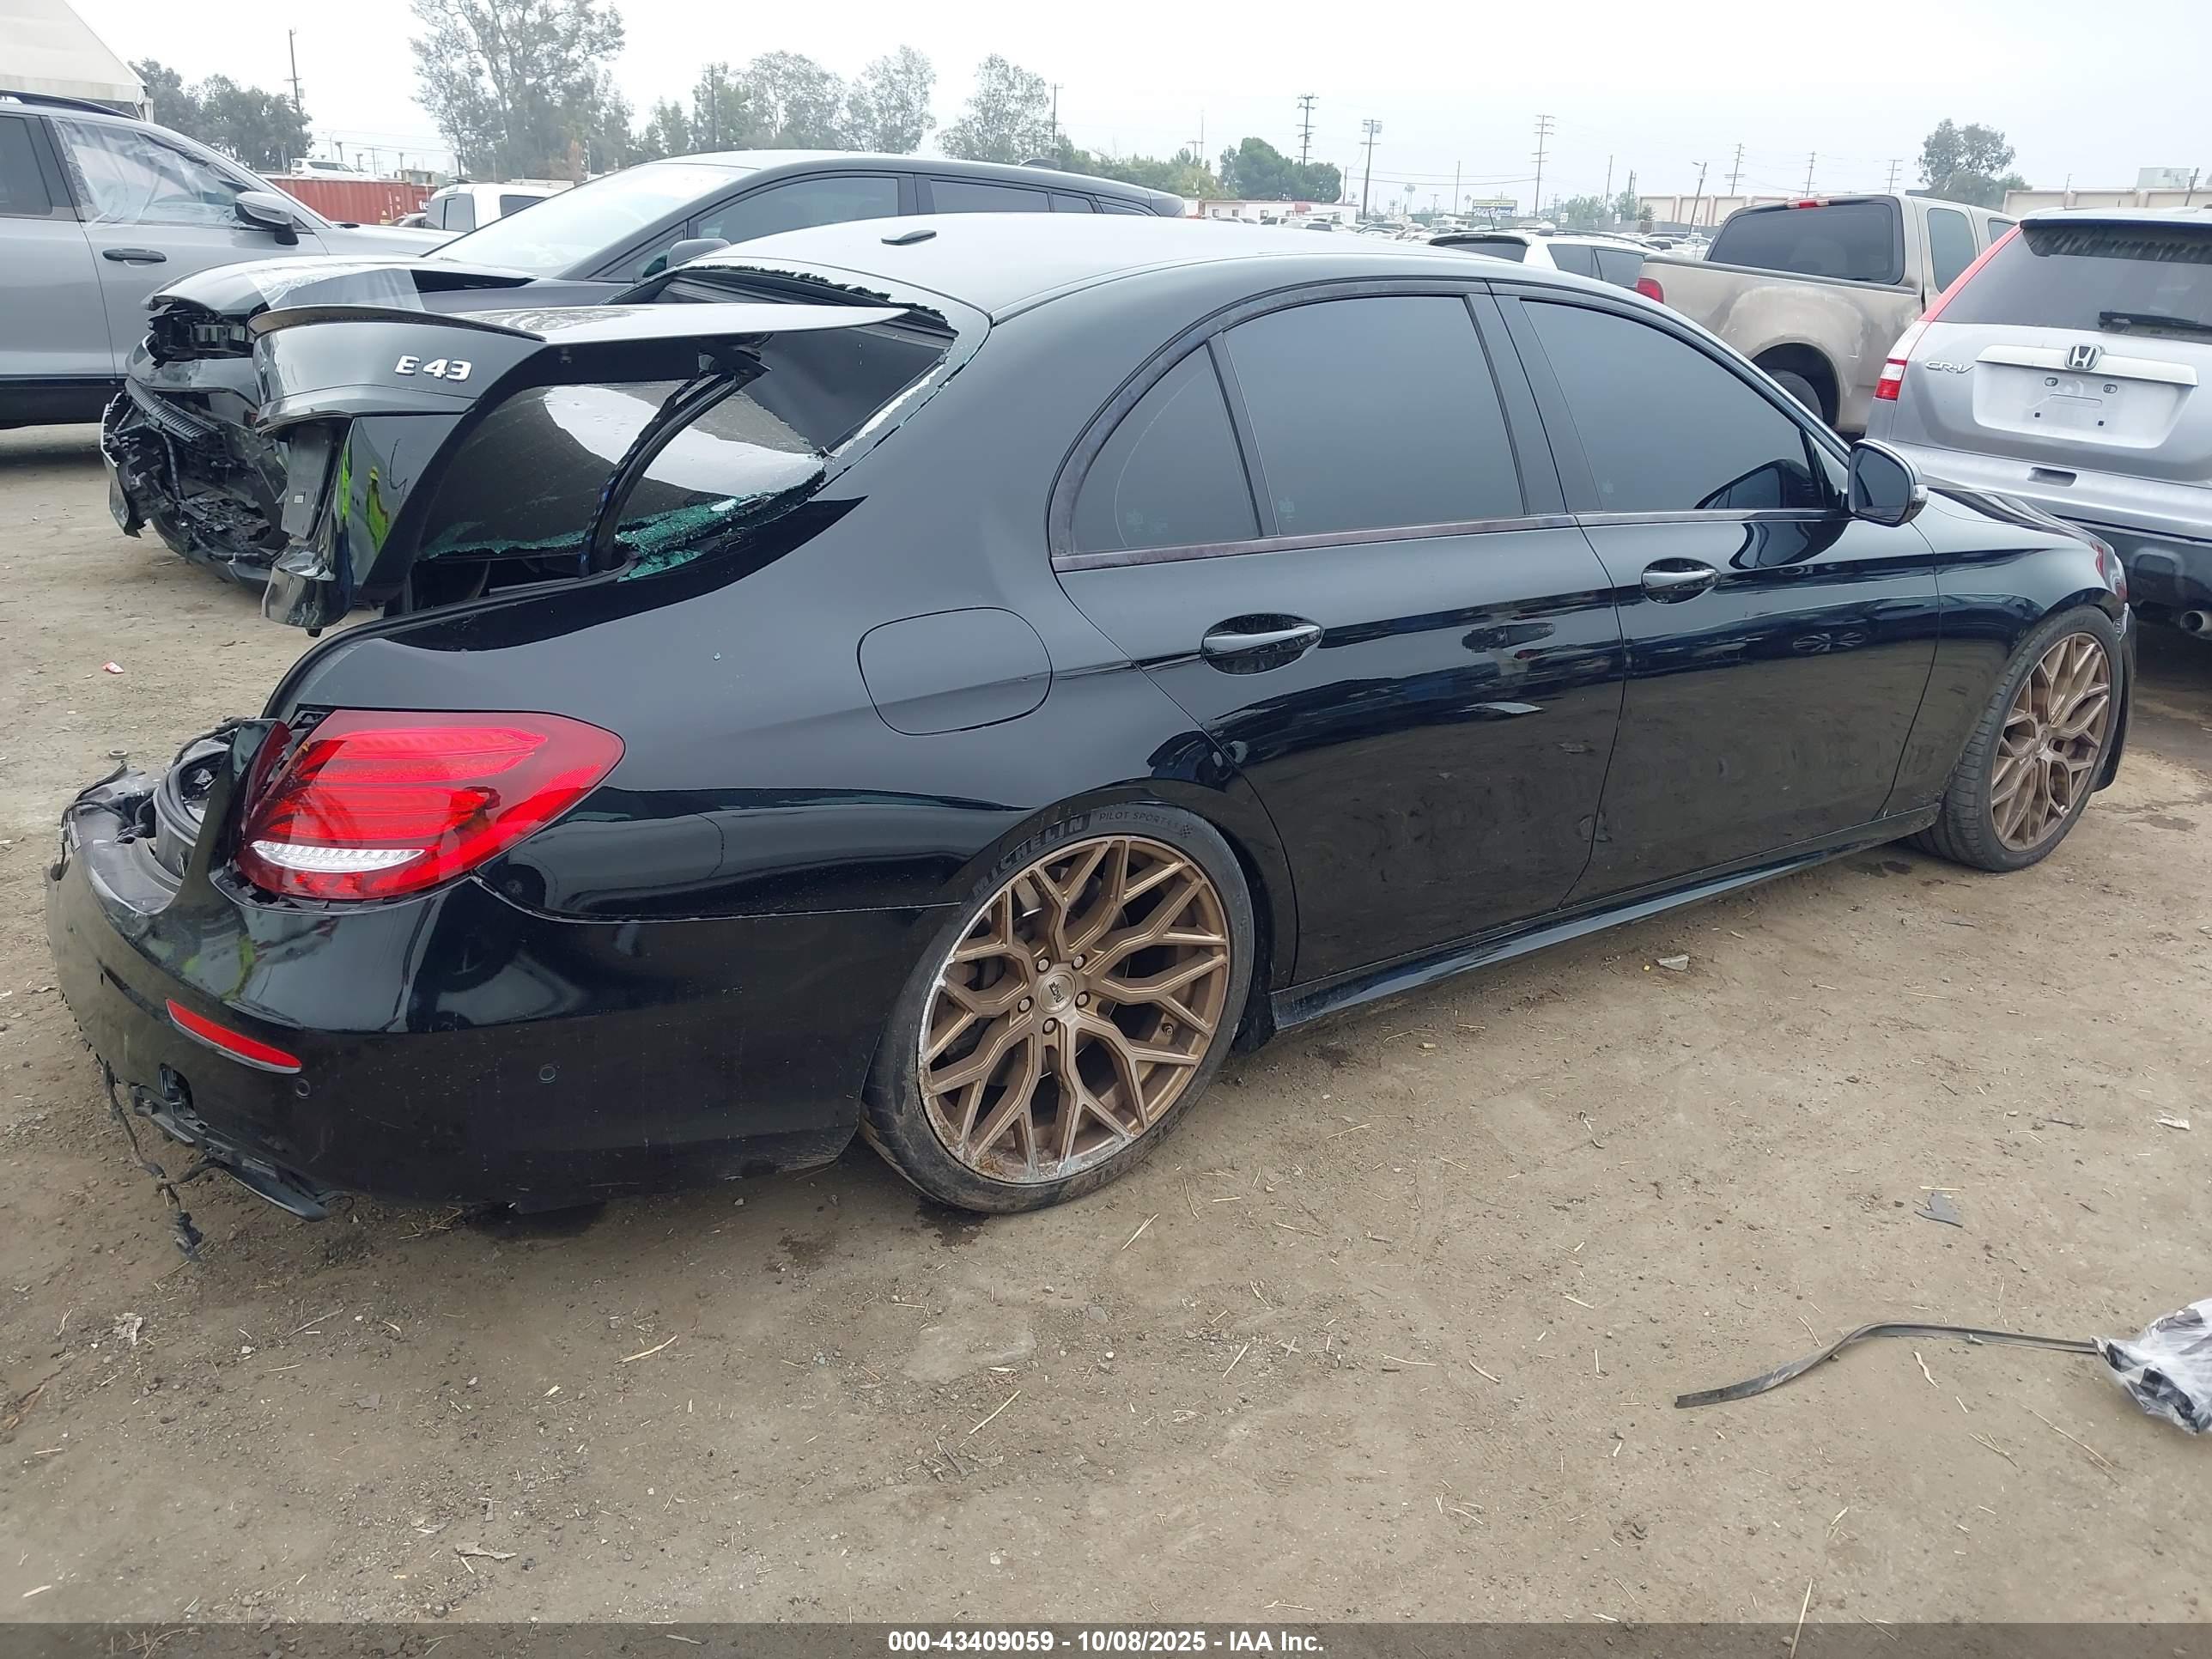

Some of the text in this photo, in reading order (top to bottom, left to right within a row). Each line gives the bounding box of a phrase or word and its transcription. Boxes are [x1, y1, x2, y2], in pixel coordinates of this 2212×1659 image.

[395, 355, 471, 382] E 43
[1099, 811, 1129, 821] PILOT
[972, 817, 1084, 897] MICHELIN
